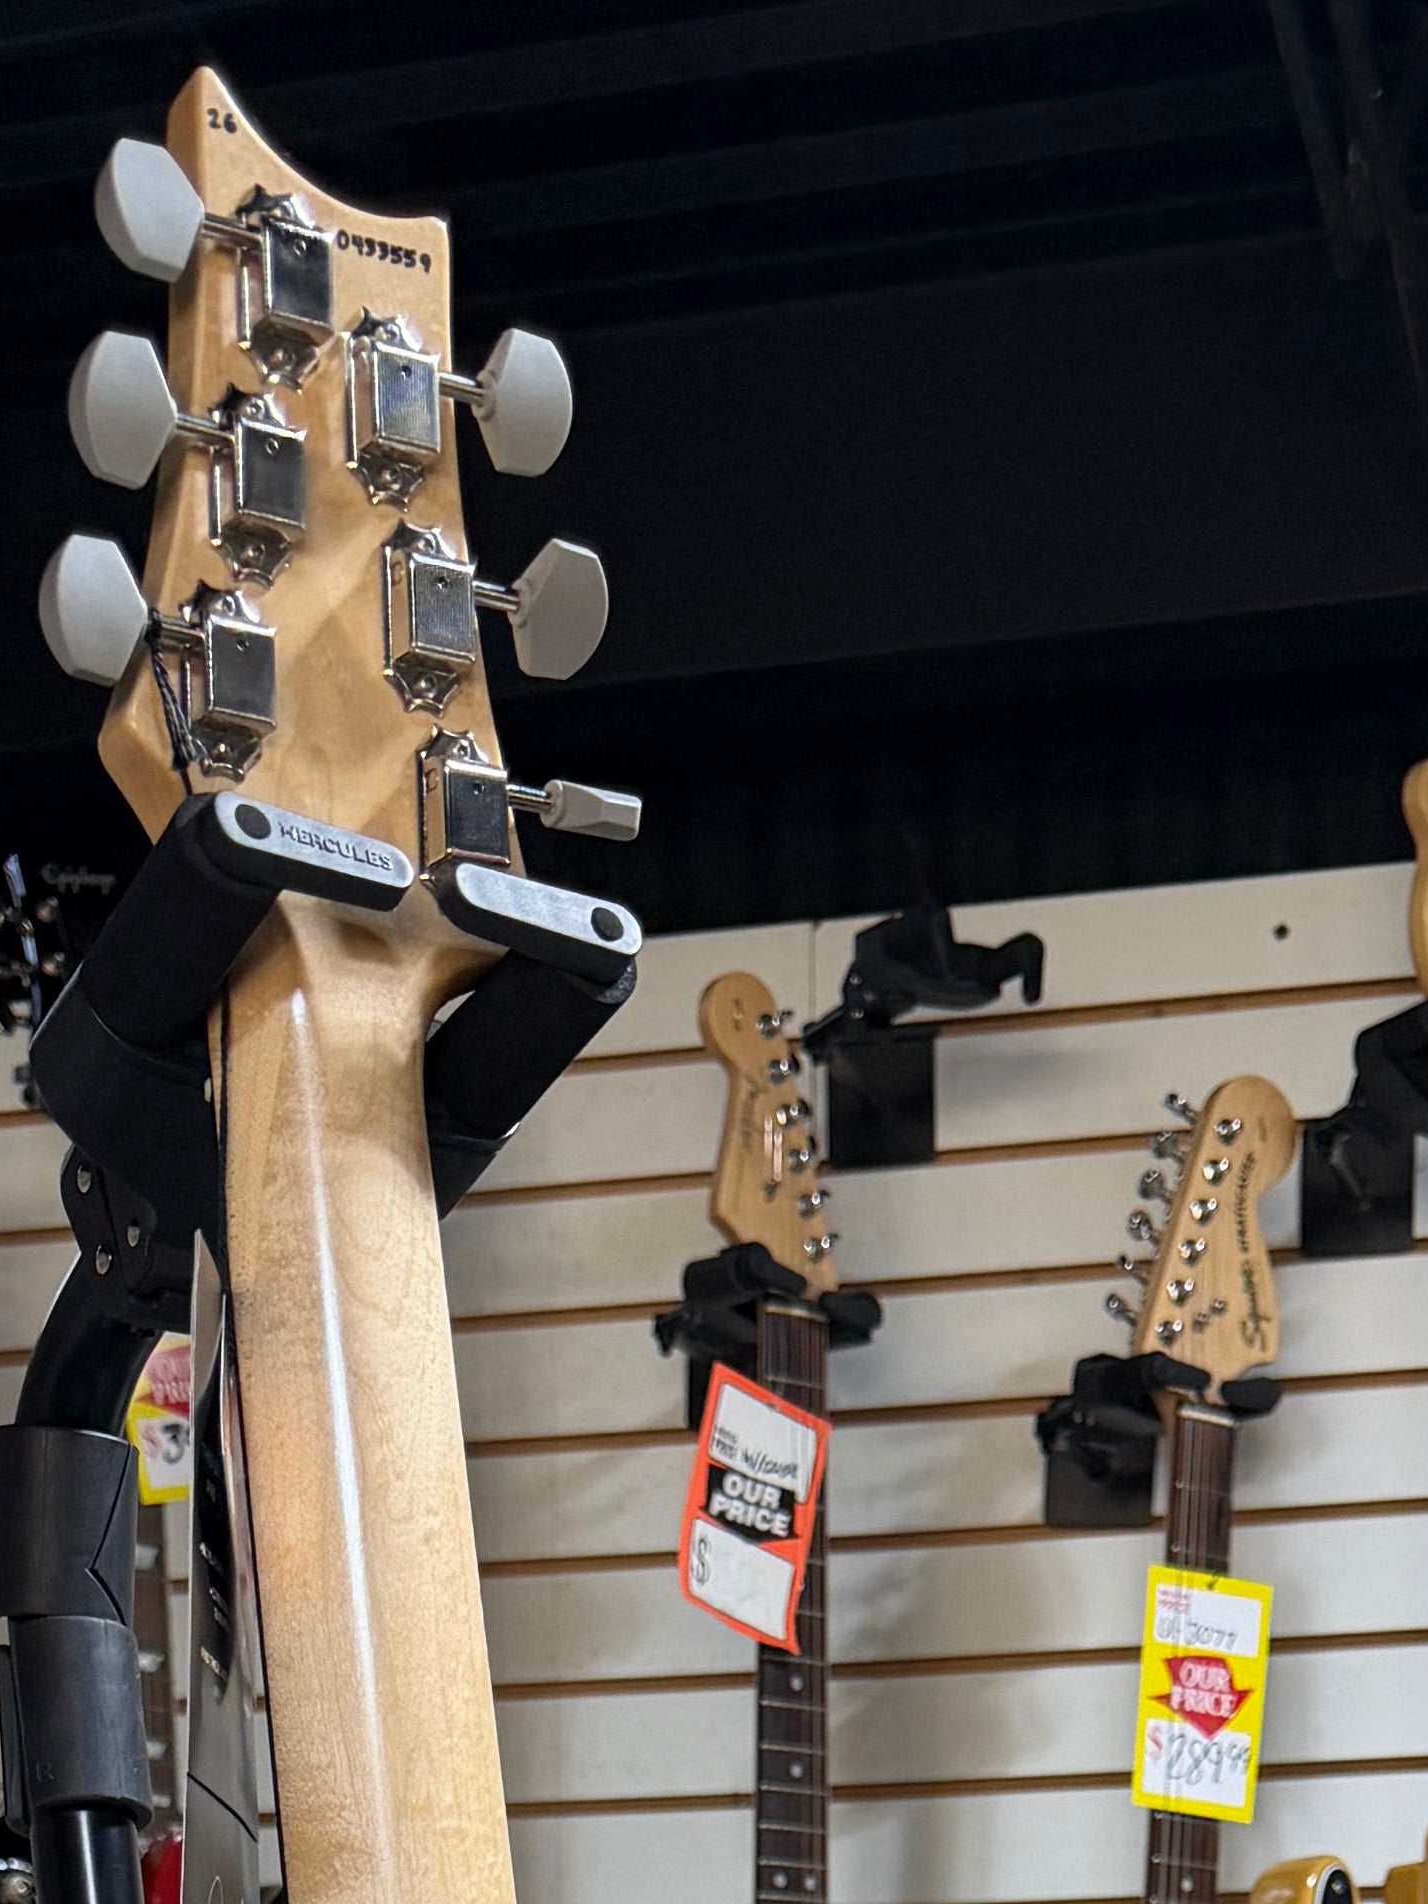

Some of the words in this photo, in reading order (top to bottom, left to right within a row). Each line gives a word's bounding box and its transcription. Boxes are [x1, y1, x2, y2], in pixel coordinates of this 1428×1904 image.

[207, 108, 238, 134] 26
[336, 229, 432, 274] 0433559
[278, 822, 393, 872] HERCULES
[722, 1471, 783, 1512] OUR
[708, 1488, 792, 1539] PRICE
[1179, 1657, 1232, 1693] OUR
[1171, 1683, 1238, 1718] PRICE
